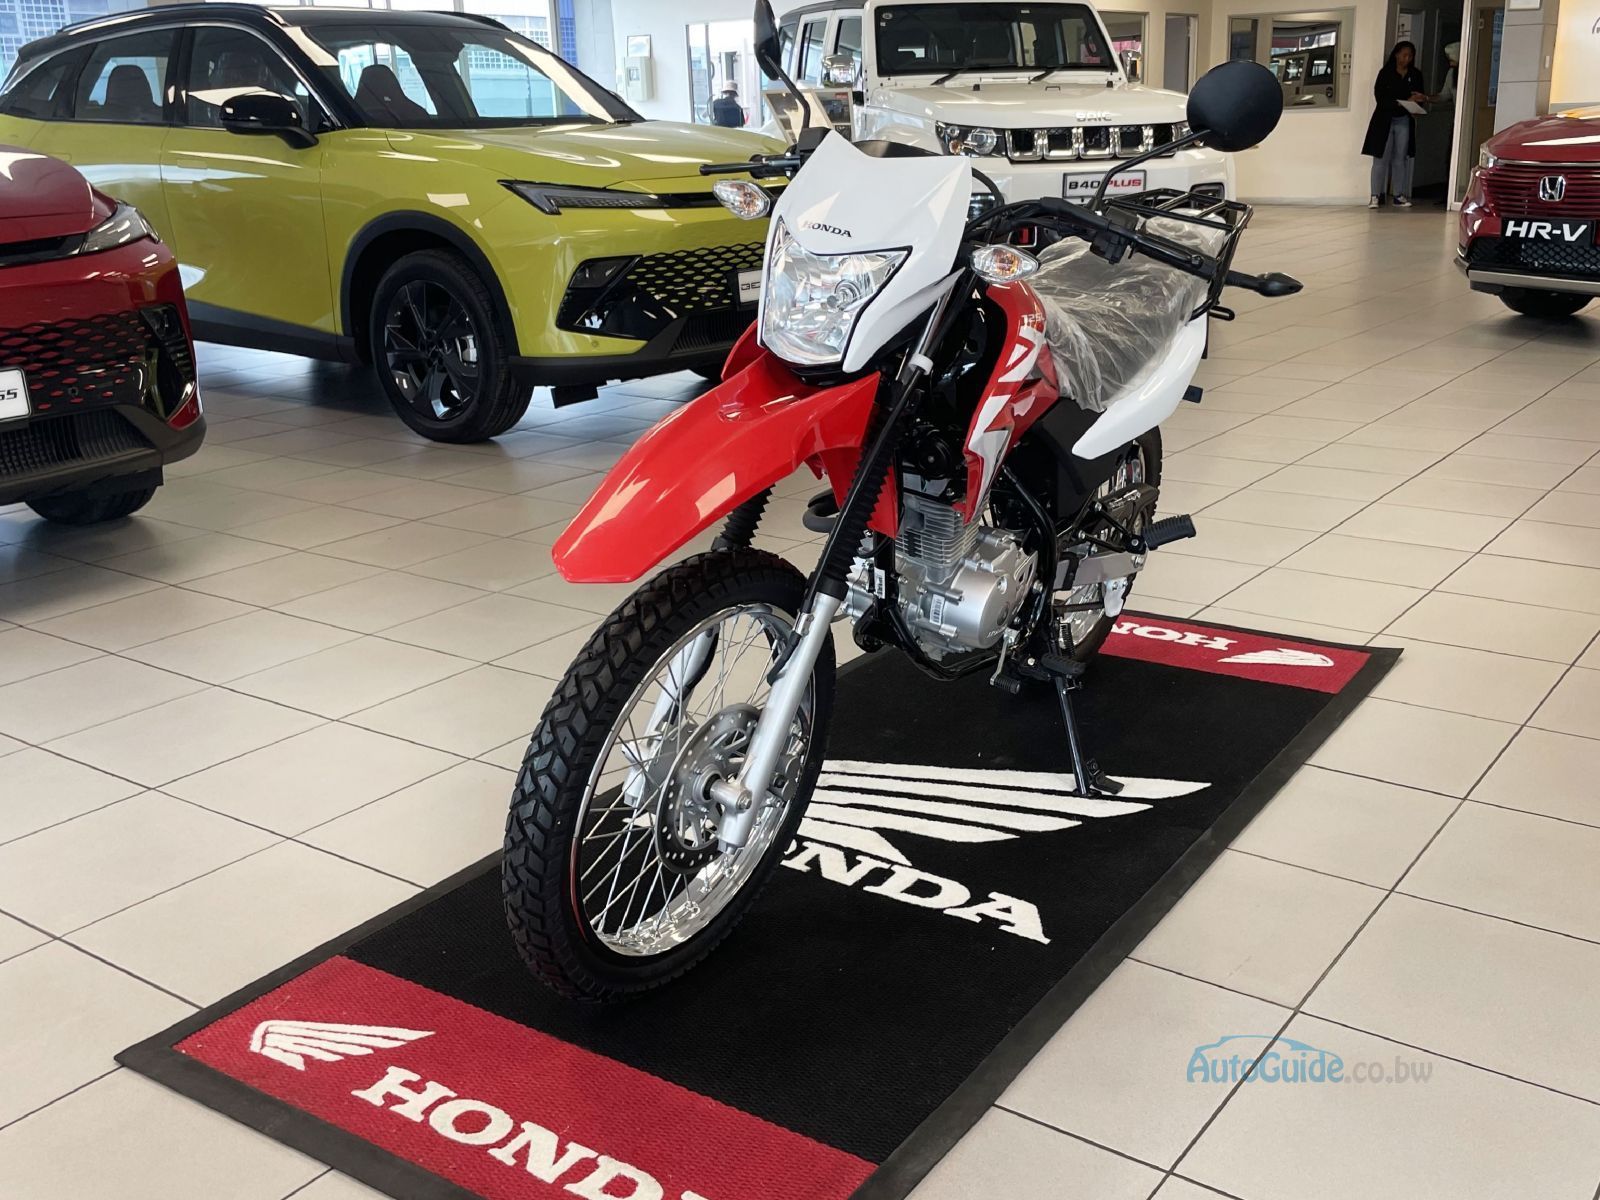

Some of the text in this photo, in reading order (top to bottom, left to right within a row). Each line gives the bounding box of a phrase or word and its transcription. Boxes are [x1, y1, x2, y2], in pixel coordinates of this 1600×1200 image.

[1068, 181, 1101, 190] B40
[802, 220, 852, 238] HONDA
[1505, 220, 1588, 242] HR-V
[780, 838, 1051, 945] NDA
[350, 1065, 709, 1200] HOND
